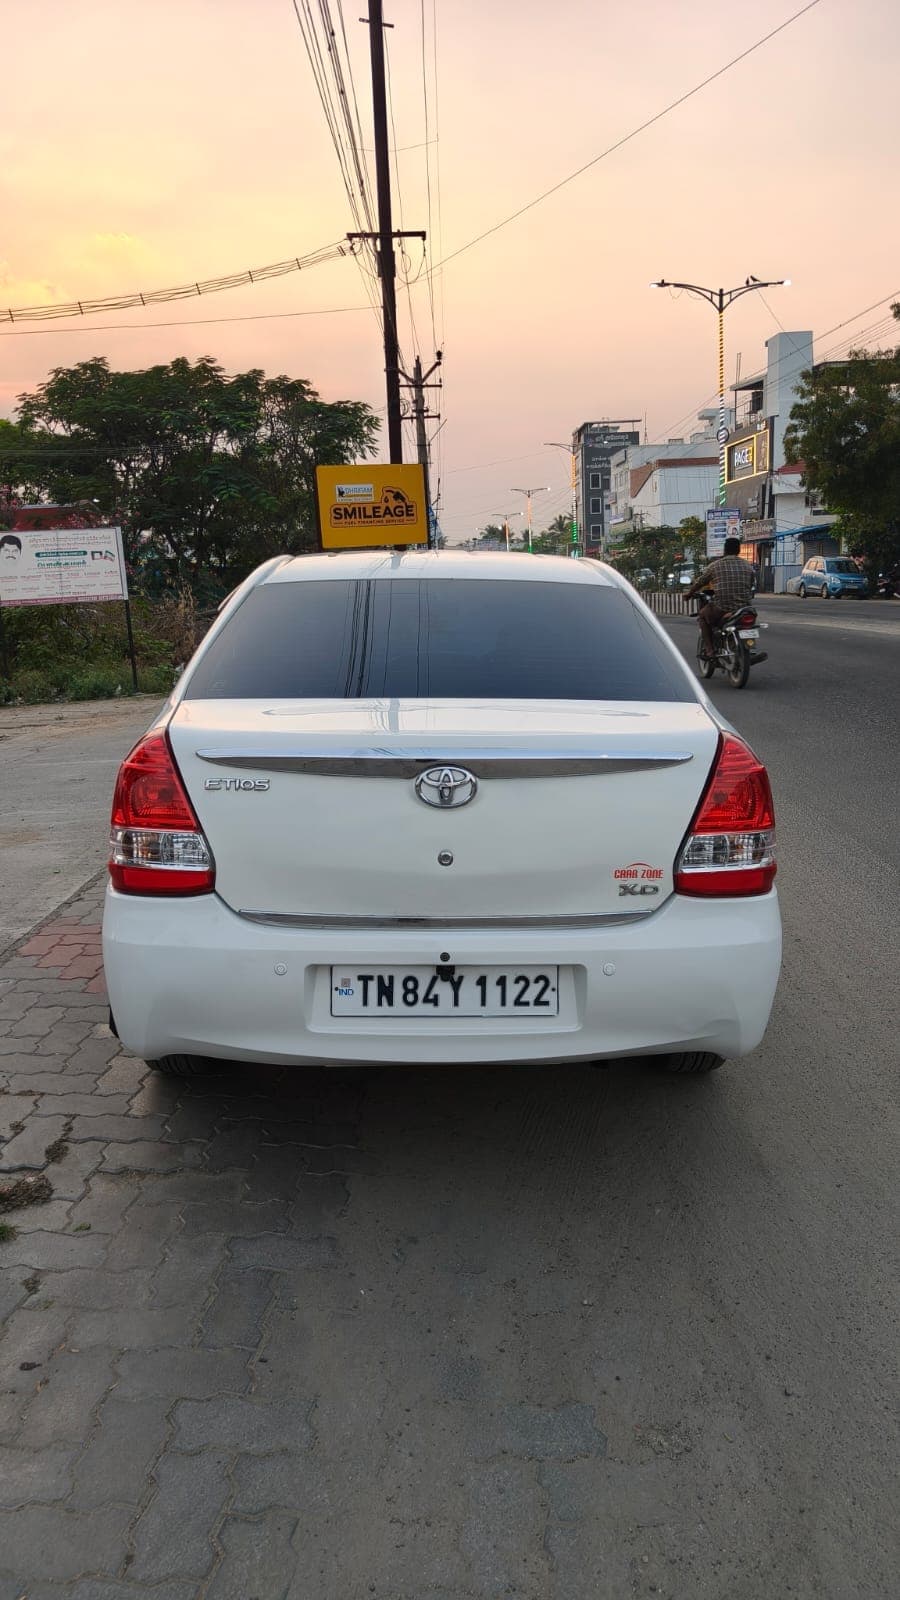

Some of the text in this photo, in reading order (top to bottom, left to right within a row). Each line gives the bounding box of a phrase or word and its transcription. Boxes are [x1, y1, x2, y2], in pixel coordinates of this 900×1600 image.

[333, 504, 415, 521] SMILEAGE
[204, 778, 271, 792] ETIOS
[641, 869, 664, 879] ZONE
[619, 883, 659, 897] XD
[339, 988, 354, 996] IND
